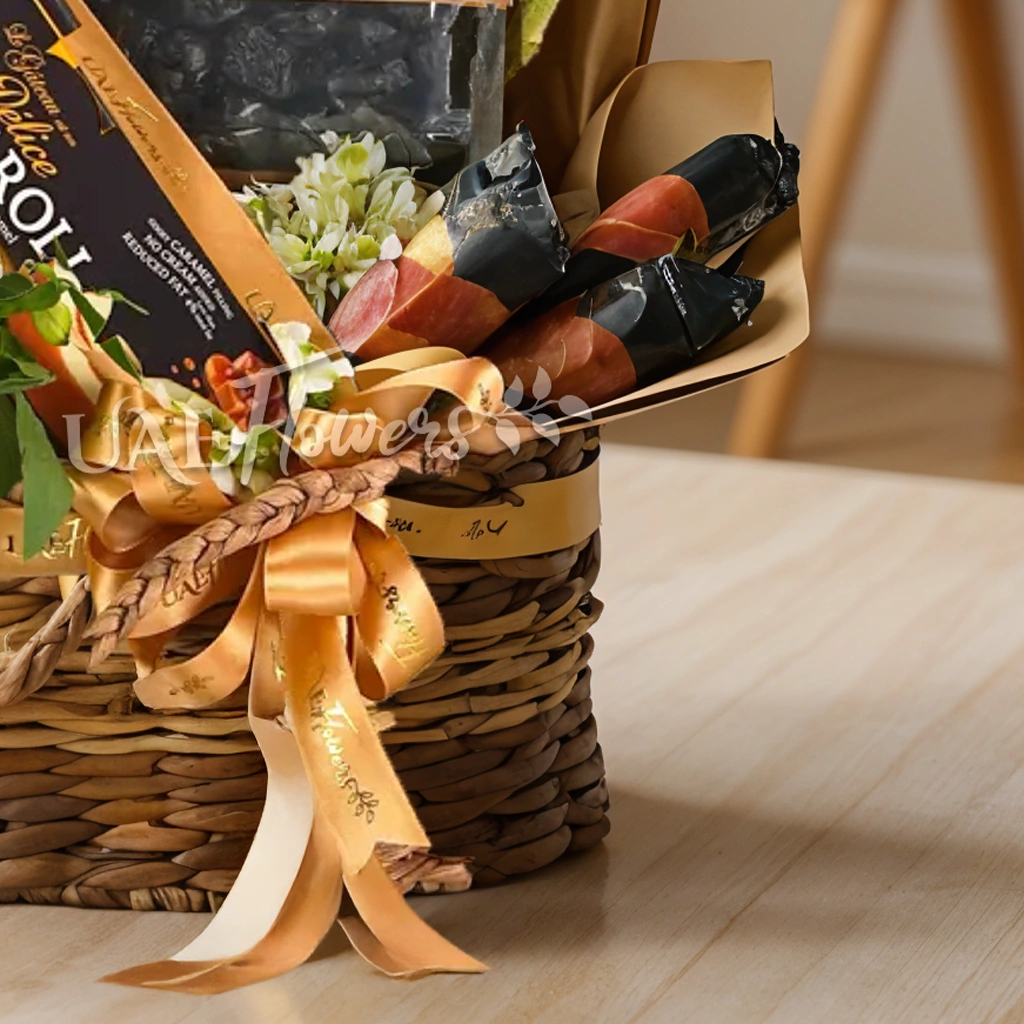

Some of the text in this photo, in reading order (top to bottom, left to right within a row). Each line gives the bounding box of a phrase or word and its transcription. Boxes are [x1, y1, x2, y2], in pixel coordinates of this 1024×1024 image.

[121, 230, 170, 280] REDUCED
[167, 275, 190, 297] FAT
[143, 233, 163, 254] NO
[160, 249, 197, 286] CREAM
[170, 239, 217, 289] CARAMEL
